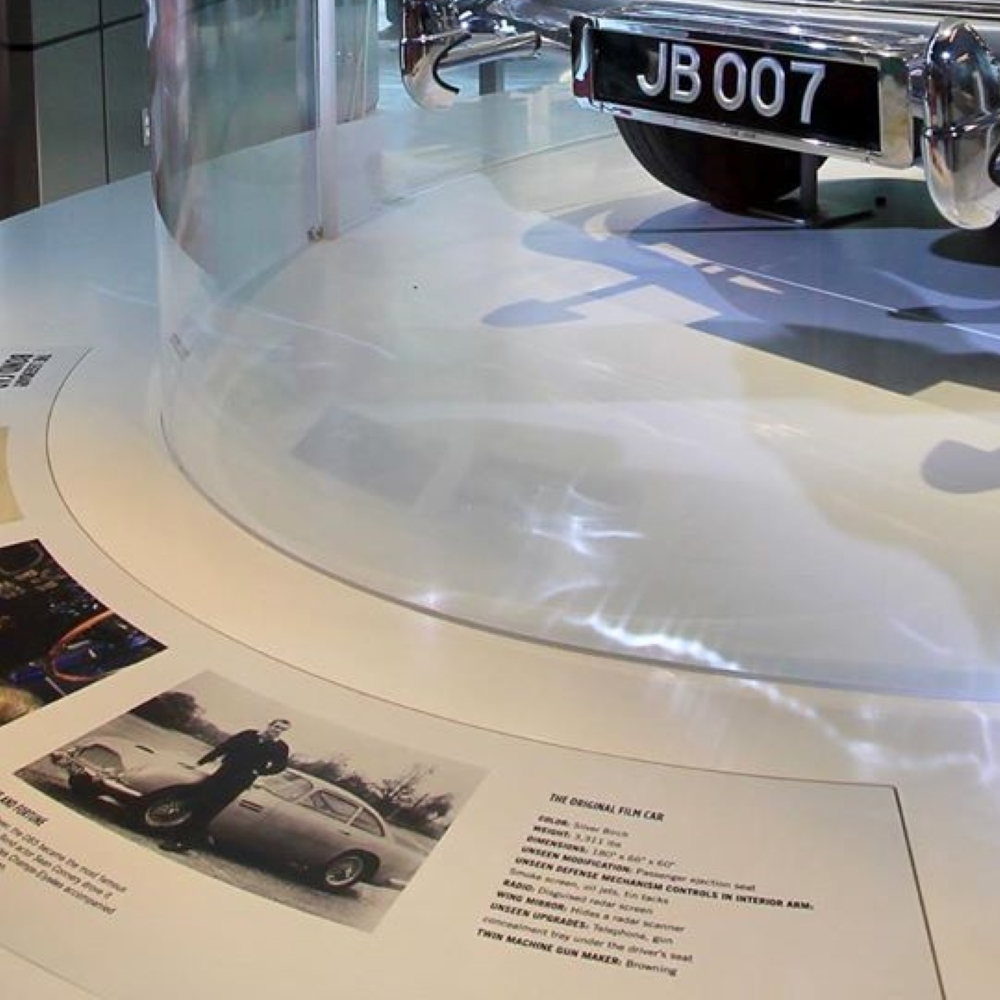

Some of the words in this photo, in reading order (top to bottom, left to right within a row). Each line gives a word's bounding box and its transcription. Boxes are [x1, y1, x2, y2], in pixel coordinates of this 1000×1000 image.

[636, 41, 702, 103] JB
[712, 50, 827, 125] 007
[549, 793, 568, 805] THE
[569, 797, 616, 814] ORIGINAL
[618, 806, 642, 818] FILM
[643, 810, 665, 822] CAR
[526, 835, 589, 853] DIMENSIONS:
[533, 825, 570, 838] WEIGHT:
[515, 857, 554, 871] UNSEEN
[555, 865, 598, 880] DEFENSE
[600, 873, 663, 891] MECHANISM
[665, 884, 718, 899] CONTROLS
[721, 893, 733, 901] IN
[736, 895, 784, 908] INTERIOR
[786, 901, 814, 910] ARM:
[521, 846, 560, 860] UNSEEN
[562, 854, 632, 873] MODIFICATION:
[636, 868, 687, 882] Passenger
[502, 879, 535, 892] RADIO:
[490, 902, 531, 917] UNSEEN
[532, 911, 589, 929] UPGRADES:
[652, 936, 674, 944] gun
[497, 891, 523, 903] WING
[525, 897, 567, 912] MIRROR:
[643, 920, 685, 932] scanner
[477, 928, 504, 941] TWIN
[505, 935, 554, 952] MACHINE
[556, 946, 579, 957] GUN
[580, 951, 622, 966] MAKER:
[625, 959, 677, 977] Browning
[482, 916, 549, 936] concealment
[573, 936, 604, 946] under
[607, 941, 625, 950] the
[669, 952, 693, 962] seat
